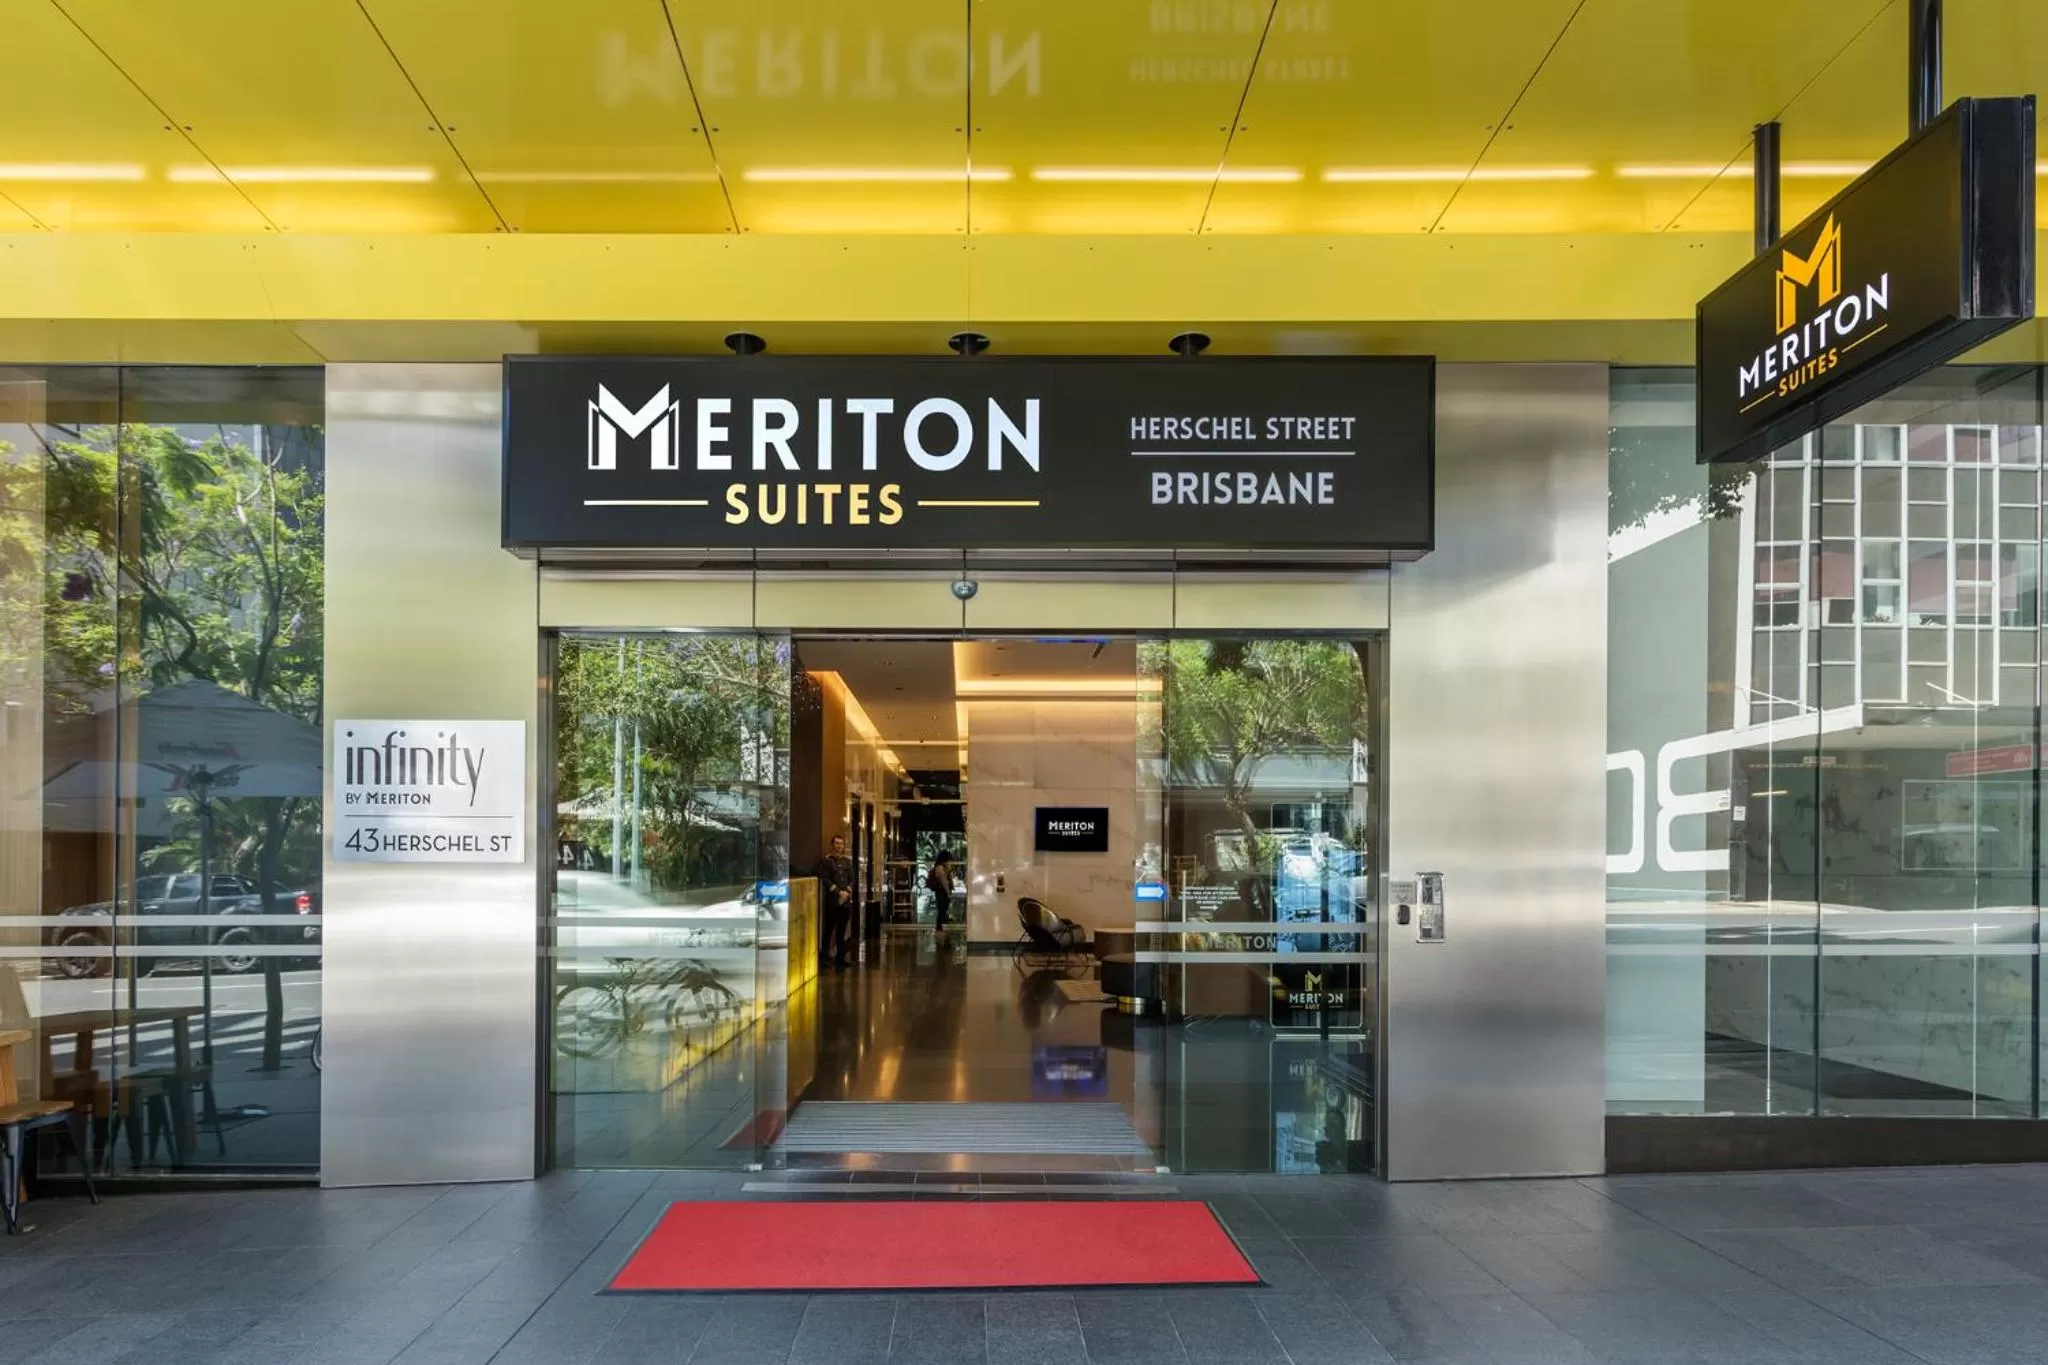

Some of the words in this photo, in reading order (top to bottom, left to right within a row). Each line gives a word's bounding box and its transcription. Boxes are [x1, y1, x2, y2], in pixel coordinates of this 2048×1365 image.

[1740, 272, 1888, 398] MERITON
[1779, 347, 1838, 397] SUITES
[588, 383, 1040, 472] MERITON
[1131, 417, 1257, 440] HERSCHEL
[1266, 417, 1356, 440] STREET
[725, 483, 903, 525] SUITES
[1151, 472, 1335, 505] BRISBANE
[346, 731, 485, 807] infinity
[346, 793, 362, 805] BY
[366, 792, 431, 805] MERITON
[345, 828, 380, 853] 43
[383, 835, 485, 852] HERSCHEL
[490, 836, 513, 852] ST
[1048, 821, 1094, 831] MERITON
